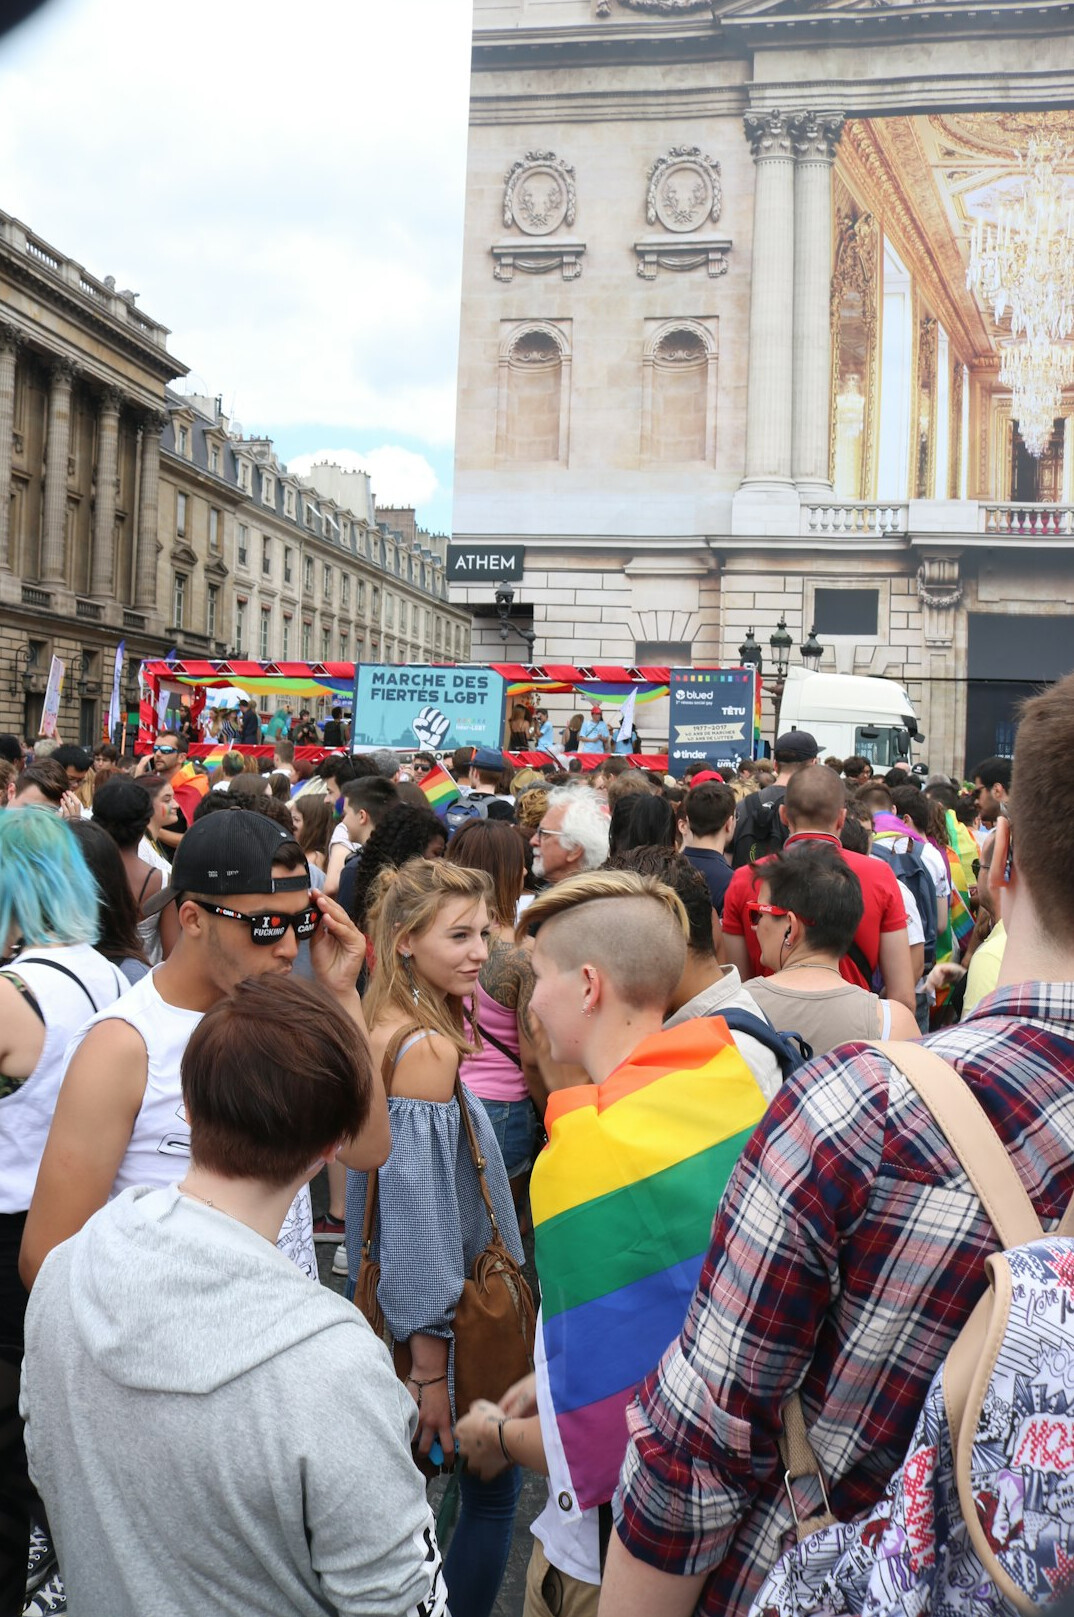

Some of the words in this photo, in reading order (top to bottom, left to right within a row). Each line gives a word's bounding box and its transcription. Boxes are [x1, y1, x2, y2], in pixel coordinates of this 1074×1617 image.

[455, 555, 515, 570] ATHEM
[372, 672, 446, 687] MARCHE
[453, 676, 488, 688] DES
[371, 687, 439, 702] FIERTÉS
[444, 692, 488, 704] LGBT
[687, 690, 713, 699] blued
[721, 706, 745, 715] TÊTU
[682, 750, 707, 759] tinder
[262, 916, 270, 928] I
[254, 927, 285, 936] FUCKING
